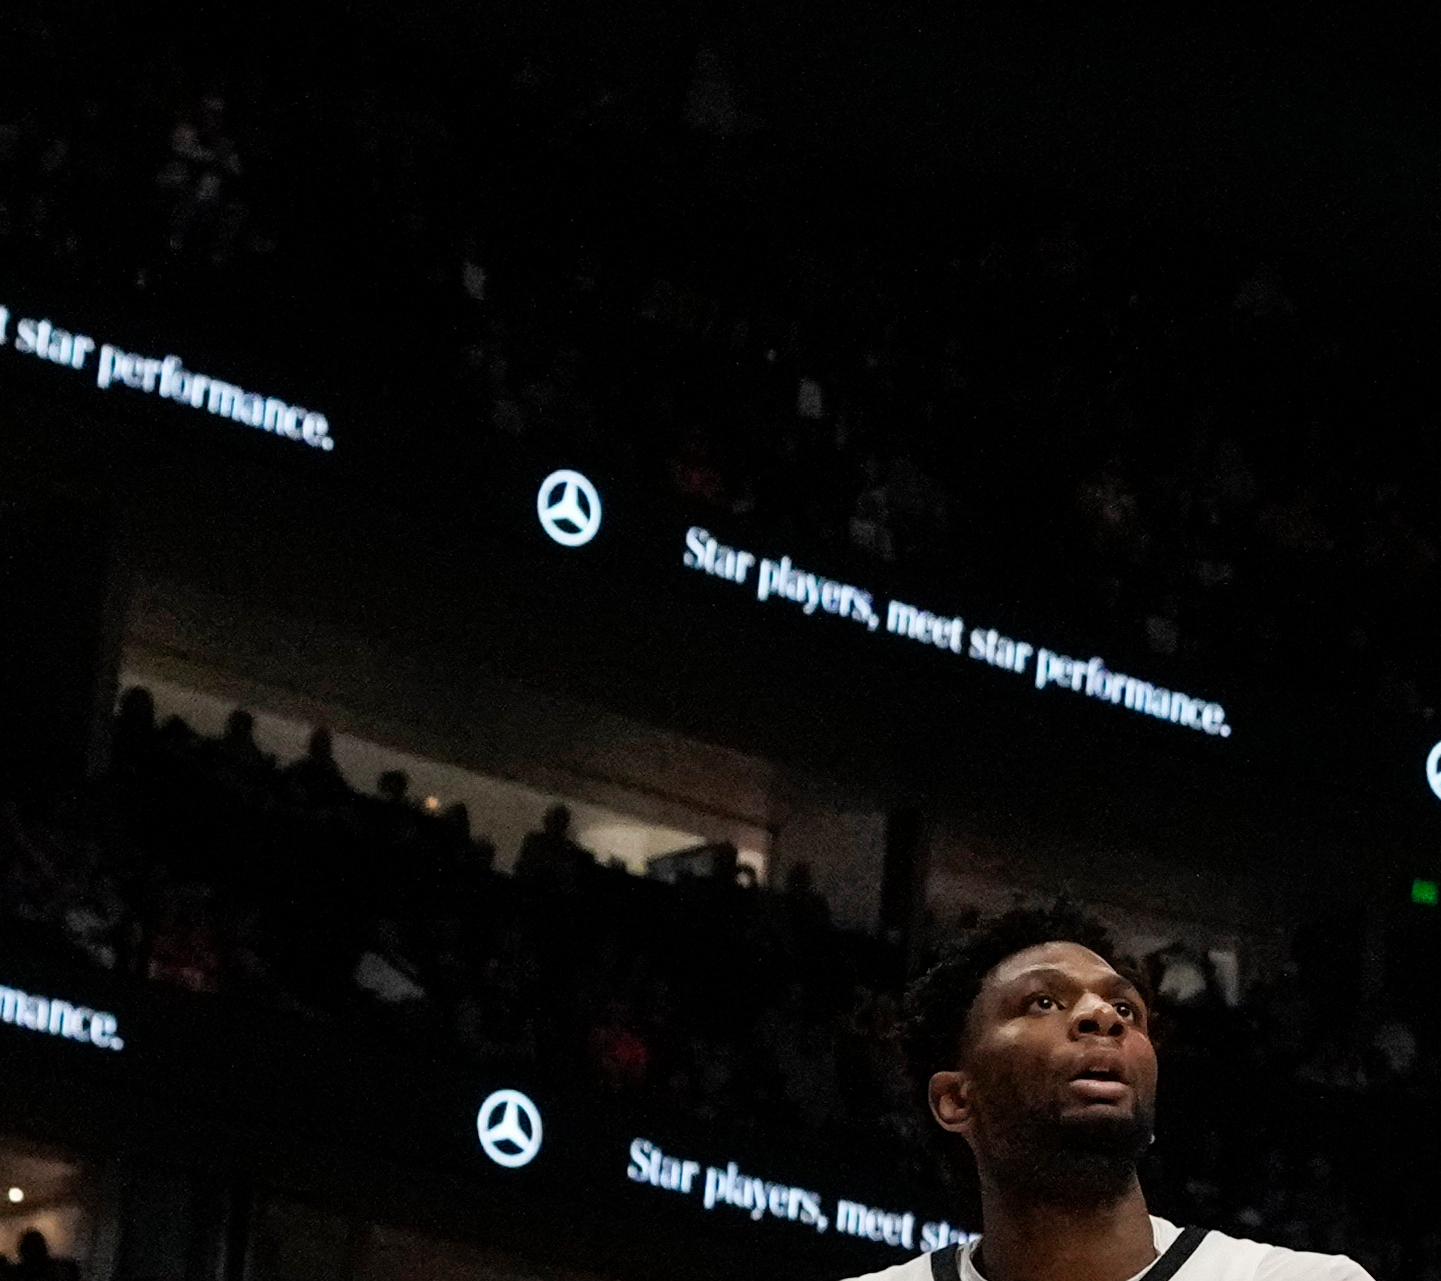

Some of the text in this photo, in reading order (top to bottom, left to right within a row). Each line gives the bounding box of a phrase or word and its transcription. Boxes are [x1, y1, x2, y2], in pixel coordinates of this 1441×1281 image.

[14, 317, 96, 370] star
[96, 342, 336, 452] performance.
[683, 525, 1233, 739] Star players, meet star performance.
[626, 1136, 700, 1195] Star
[702, 1160, 829, 1234] players,
[836, 1197, 916, 1251] meet
